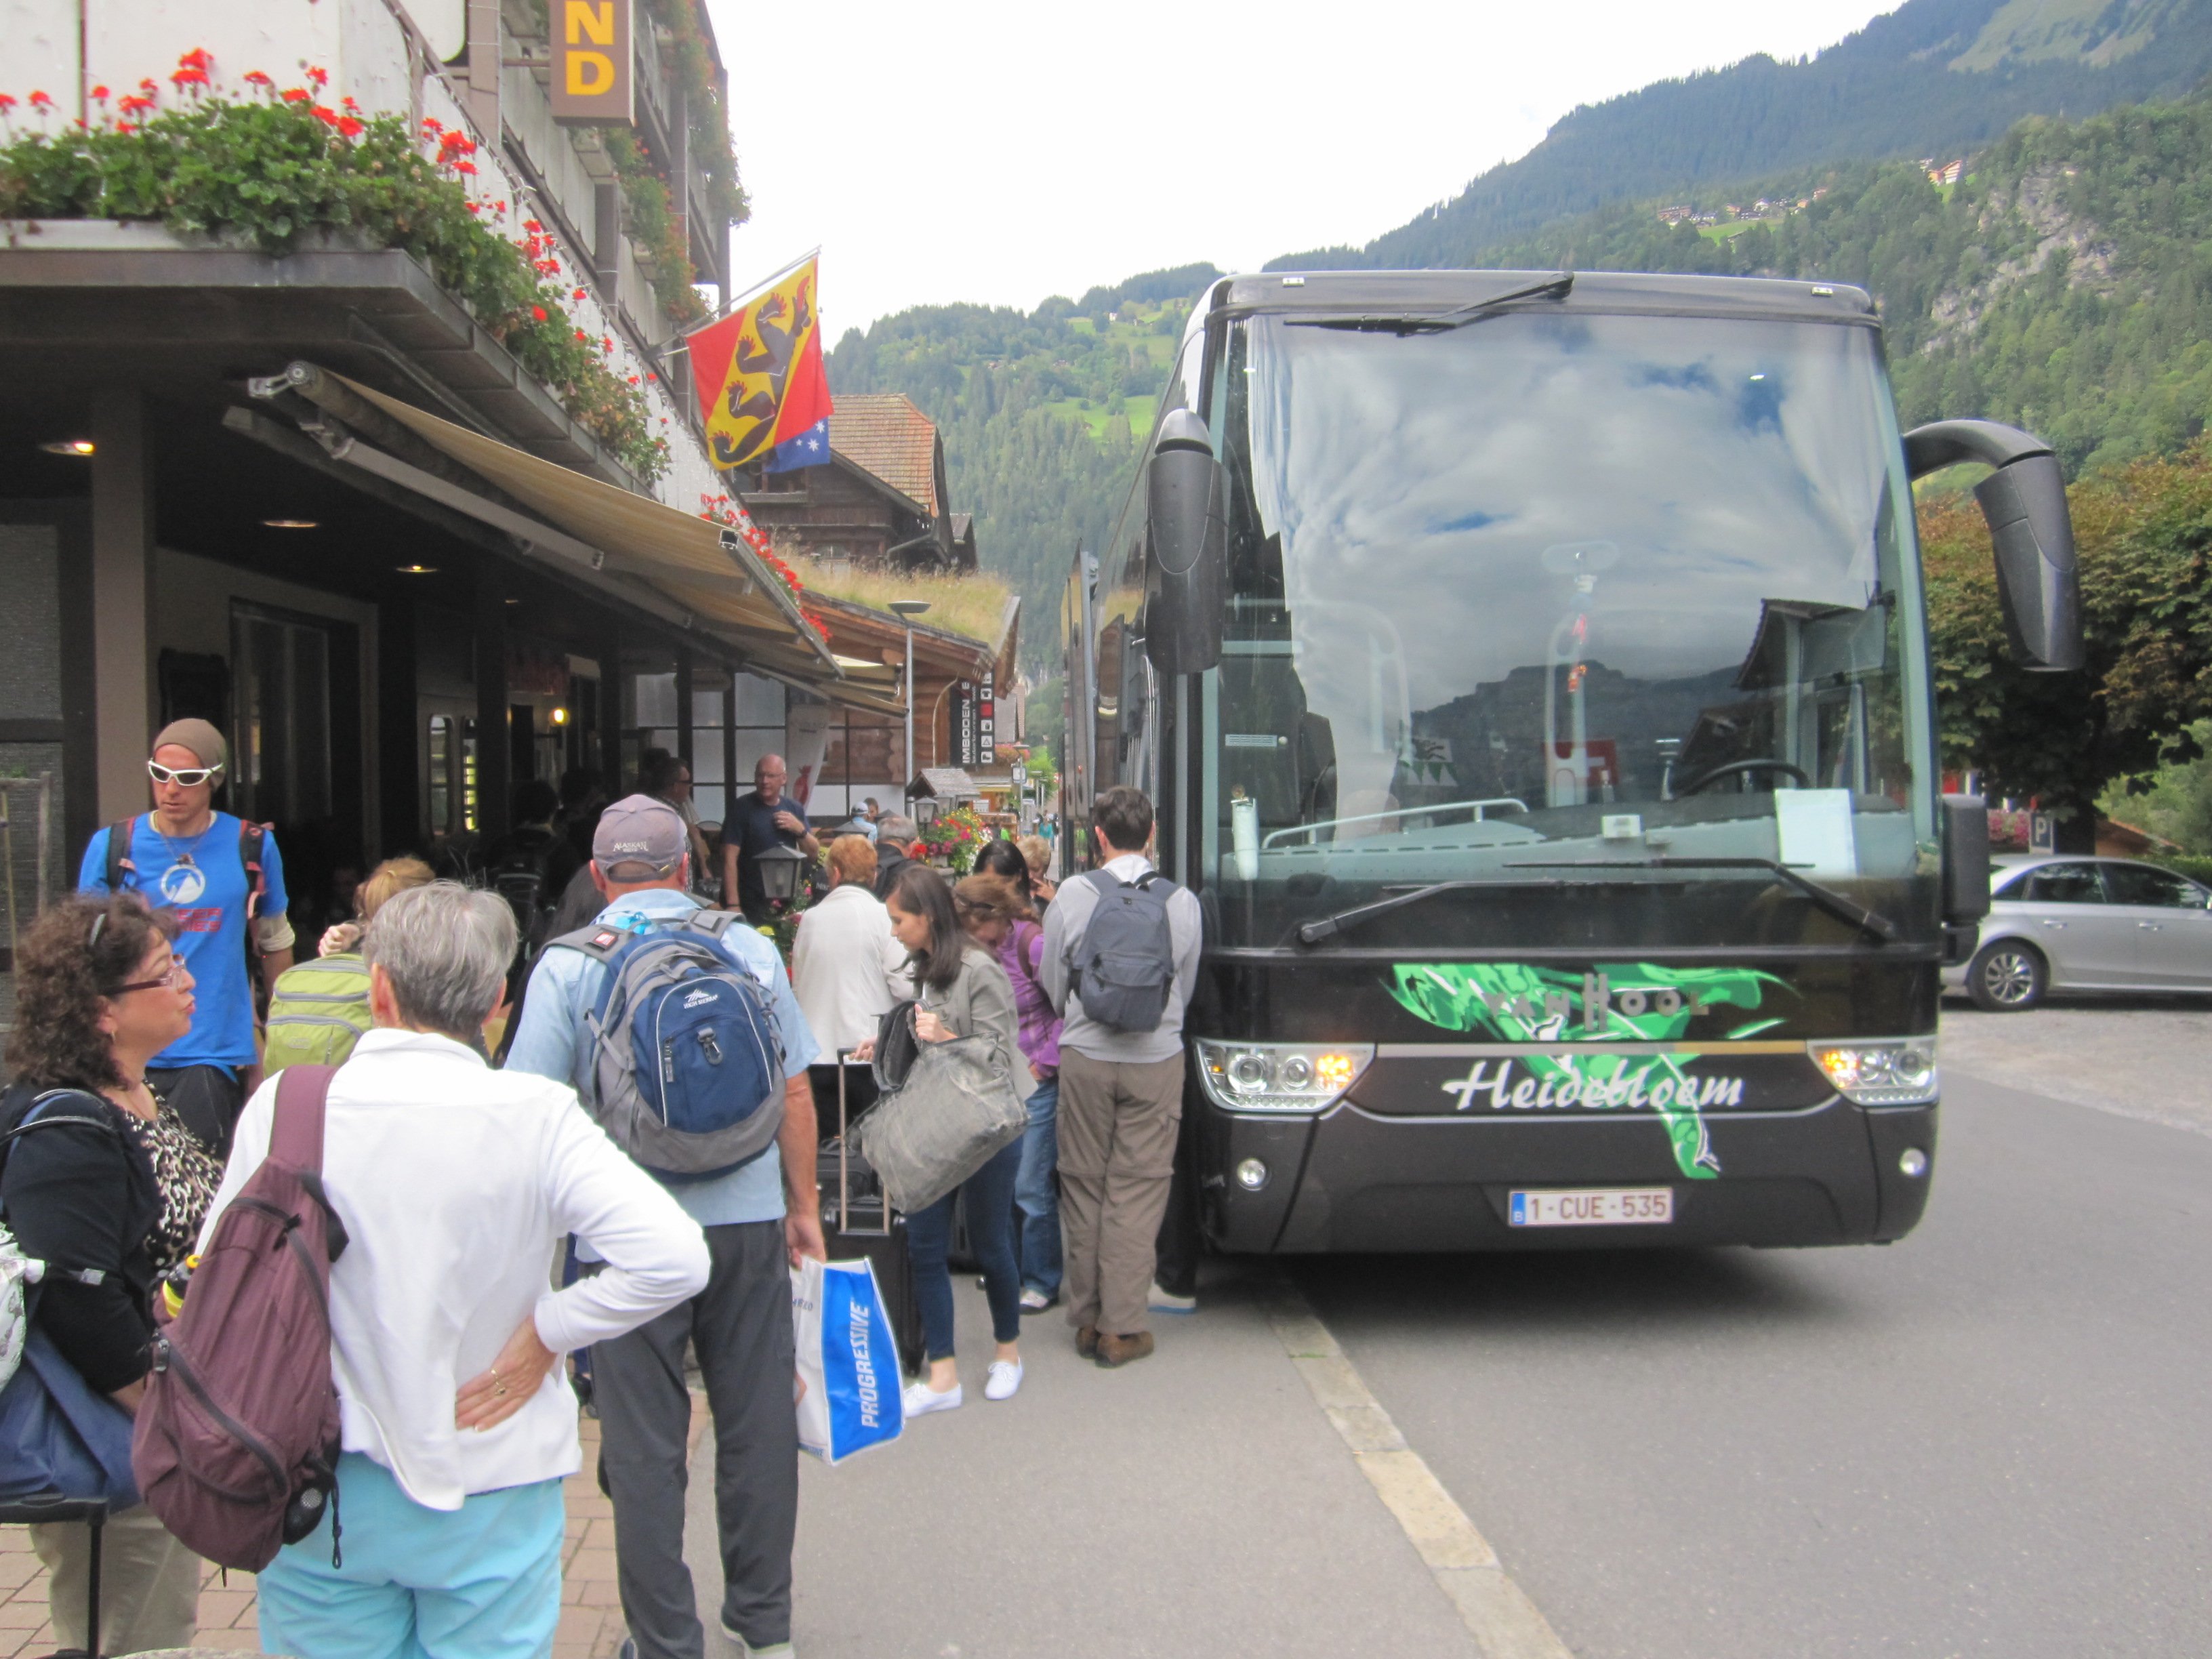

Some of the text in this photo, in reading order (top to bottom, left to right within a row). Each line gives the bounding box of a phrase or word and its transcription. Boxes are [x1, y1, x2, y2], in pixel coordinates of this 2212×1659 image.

[962, 699, 970, 764] IMBODEN
[2036, 817, 2047, 842] P
[1483, 973, 1709, 1031] VAN HOOL
[1441, 1059, 1745, 1110] Heidebloem
[849, 1299, 879, 1429] PROGRESSIVE
